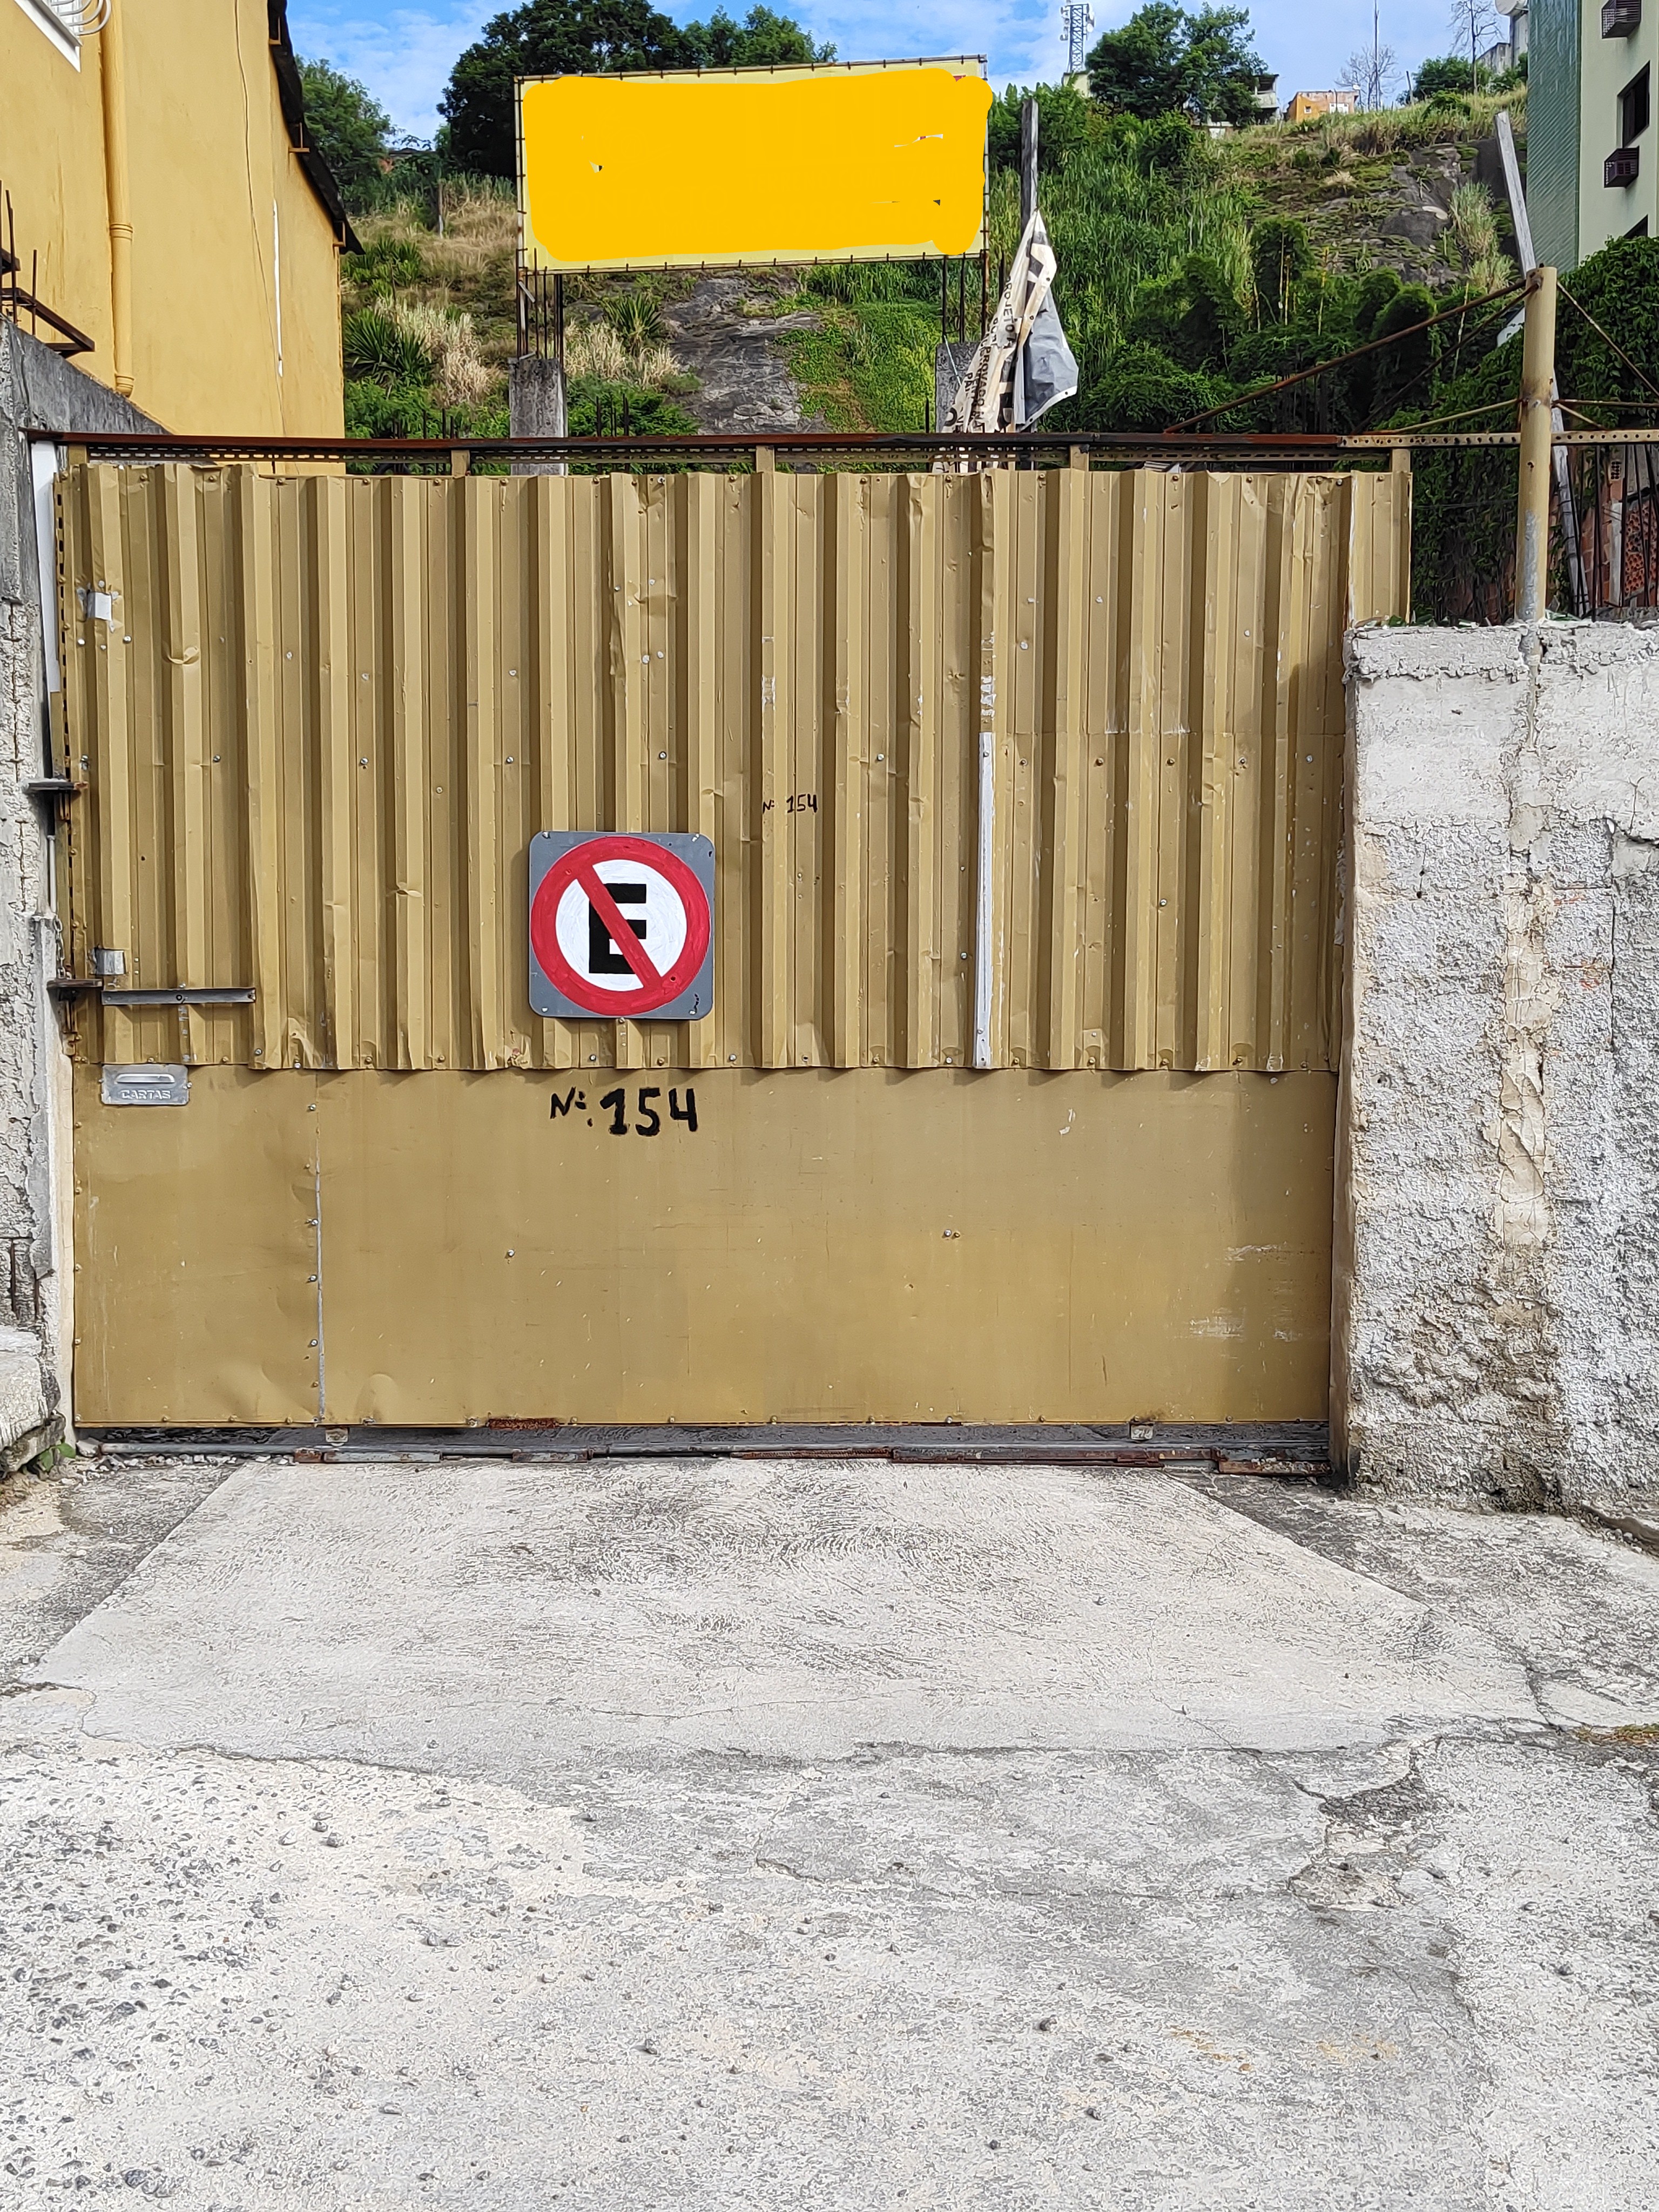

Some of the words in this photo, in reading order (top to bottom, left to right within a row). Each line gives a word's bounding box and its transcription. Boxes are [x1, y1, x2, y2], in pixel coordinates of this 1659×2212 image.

[786, 793, 818, 813] 154
[589, 883, 646, 974] E
[120, 1090, 172, 1100] CARTAS
[599, 1087, 698, 1137] 154
